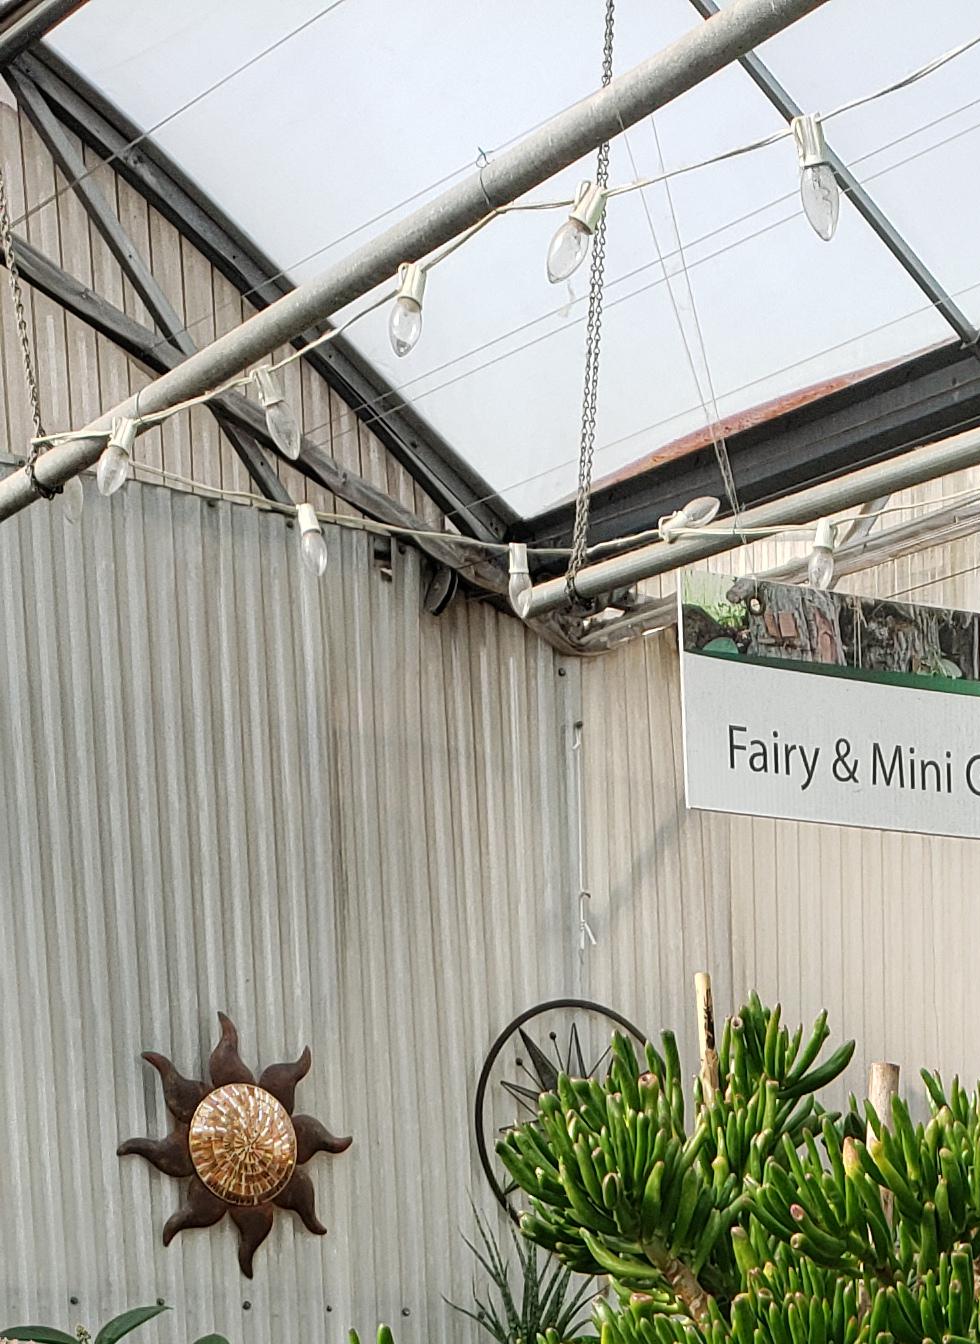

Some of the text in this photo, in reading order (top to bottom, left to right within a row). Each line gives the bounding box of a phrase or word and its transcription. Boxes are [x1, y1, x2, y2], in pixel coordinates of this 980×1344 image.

[728, 724, 820, 791] Fairy
[832, 737, 859, 783] &
[872, 742, 952, 793] Mini
